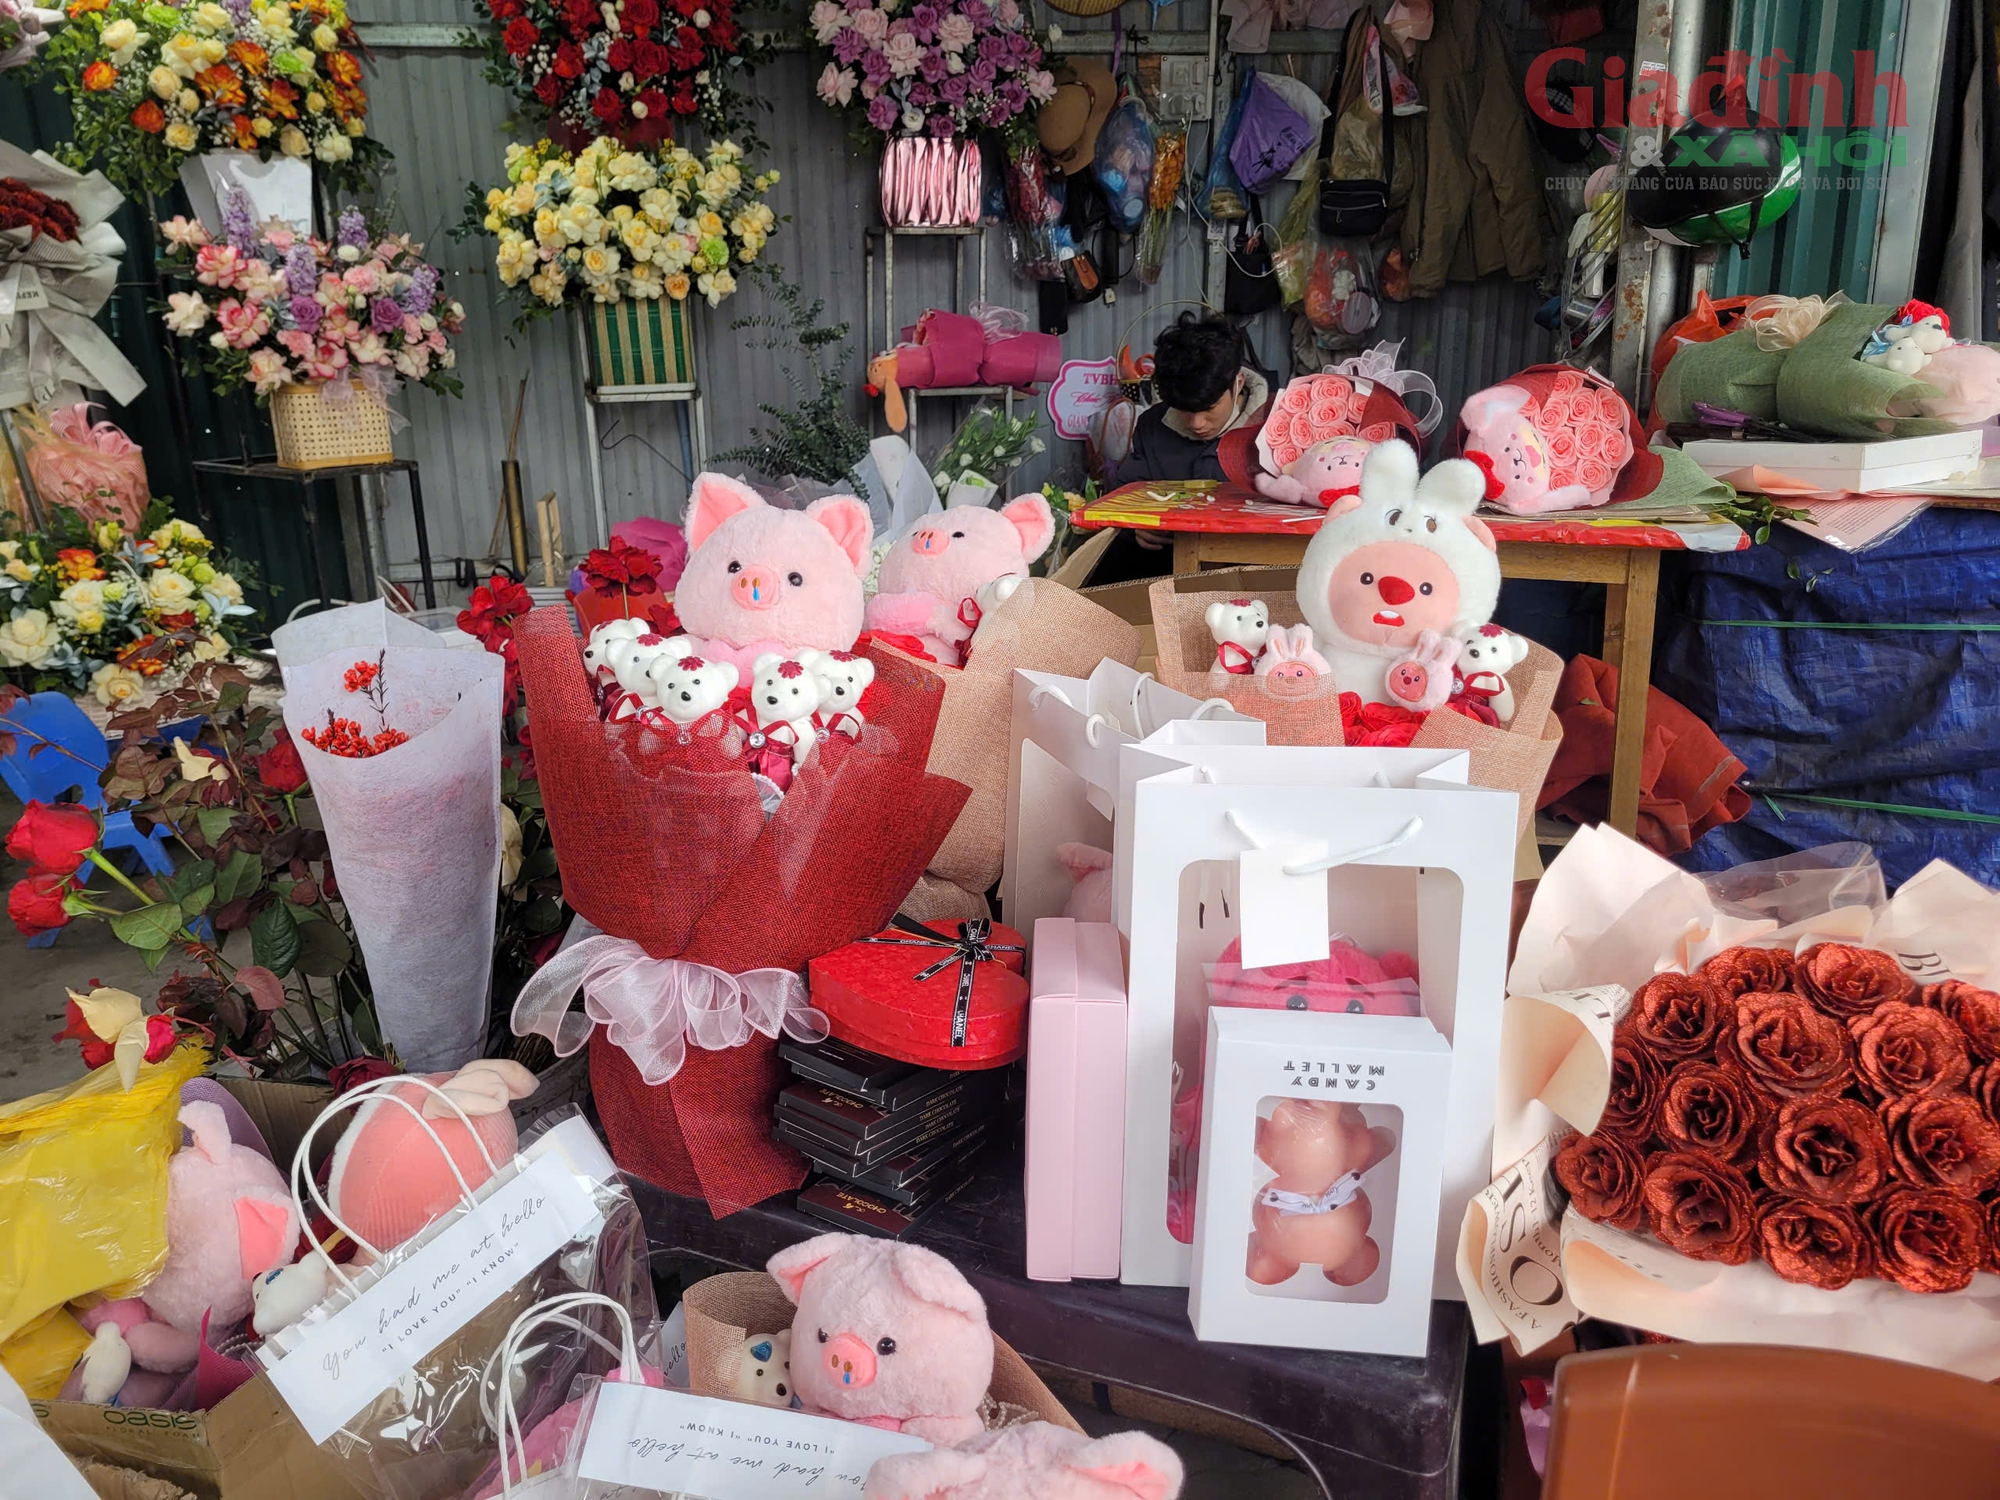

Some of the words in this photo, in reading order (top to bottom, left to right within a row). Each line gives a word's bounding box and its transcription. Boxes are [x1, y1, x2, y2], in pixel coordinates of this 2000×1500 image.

[1283, 1060, 1385, 1076] MALLET
[1290, 1076, 1376, 1091] CANDY
[837, 1192, 887, 1215] CHOCOLATE
[322, 1335, 367, 1380] You
[378, 1286, 421, 1334] had
[432, 1262, 461, 1290] me
[470, 1233, 495, 1259] at
[501, 1195, 546, 1238] hello
[397, 1315, 428, 1343] LOVE
[627, 1437, 686, 1463] hello
[687, 1447, 719, 1460] at
[786, 1440, 818, 1452] LOVE
[730, 1456, 763, 1468] me
[773, 1462, 825, 1487] had
